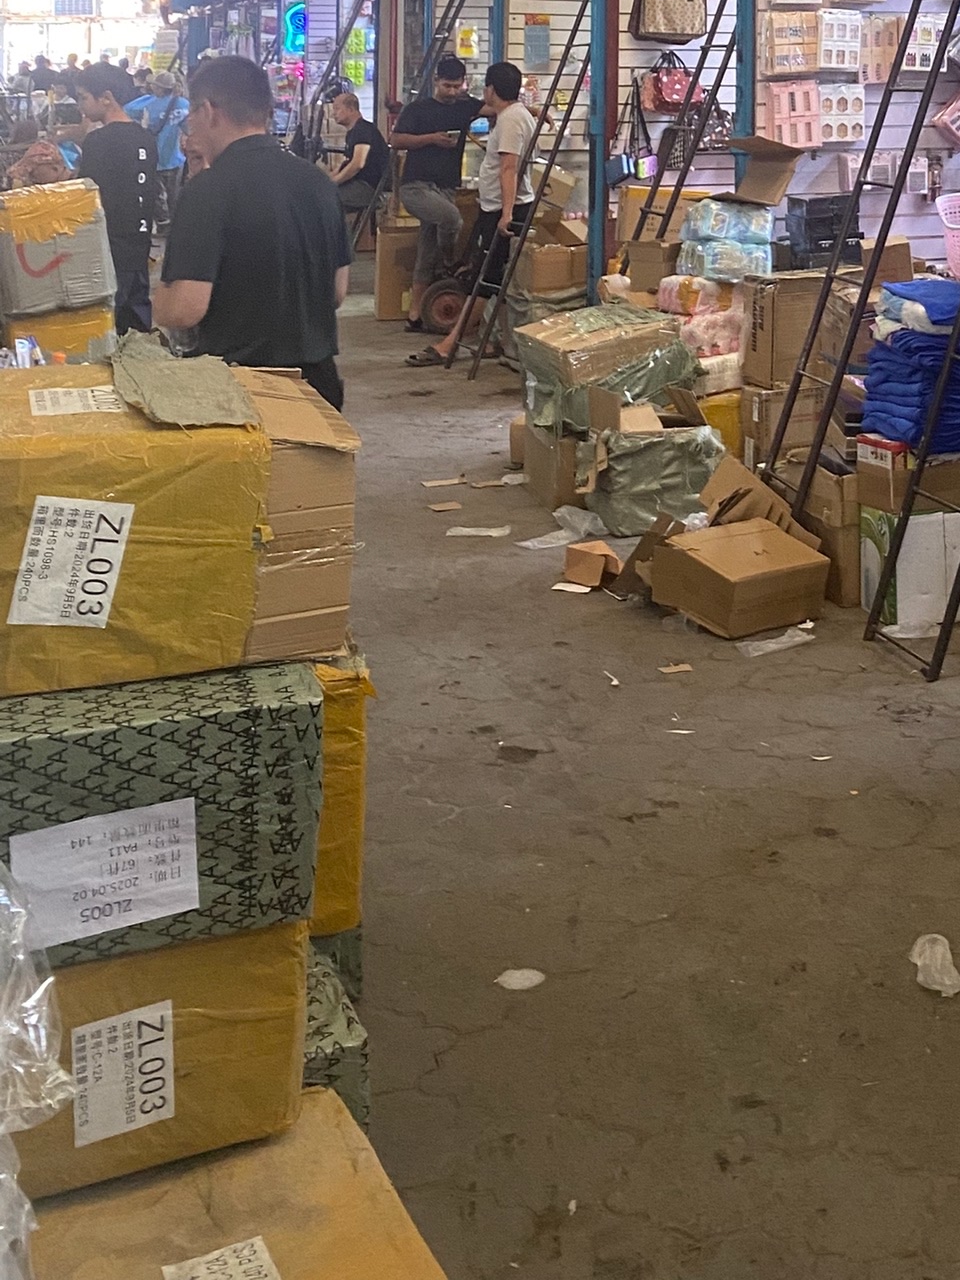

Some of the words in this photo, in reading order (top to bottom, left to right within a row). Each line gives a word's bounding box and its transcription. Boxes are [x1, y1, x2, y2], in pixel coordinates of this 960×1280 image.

[76, 513, 125, 615] ZL003
[70, 835, 92, 850] 144
[80, 898, 133, 923] ZL005
[137, 1015, 167, 1115] ZL003
